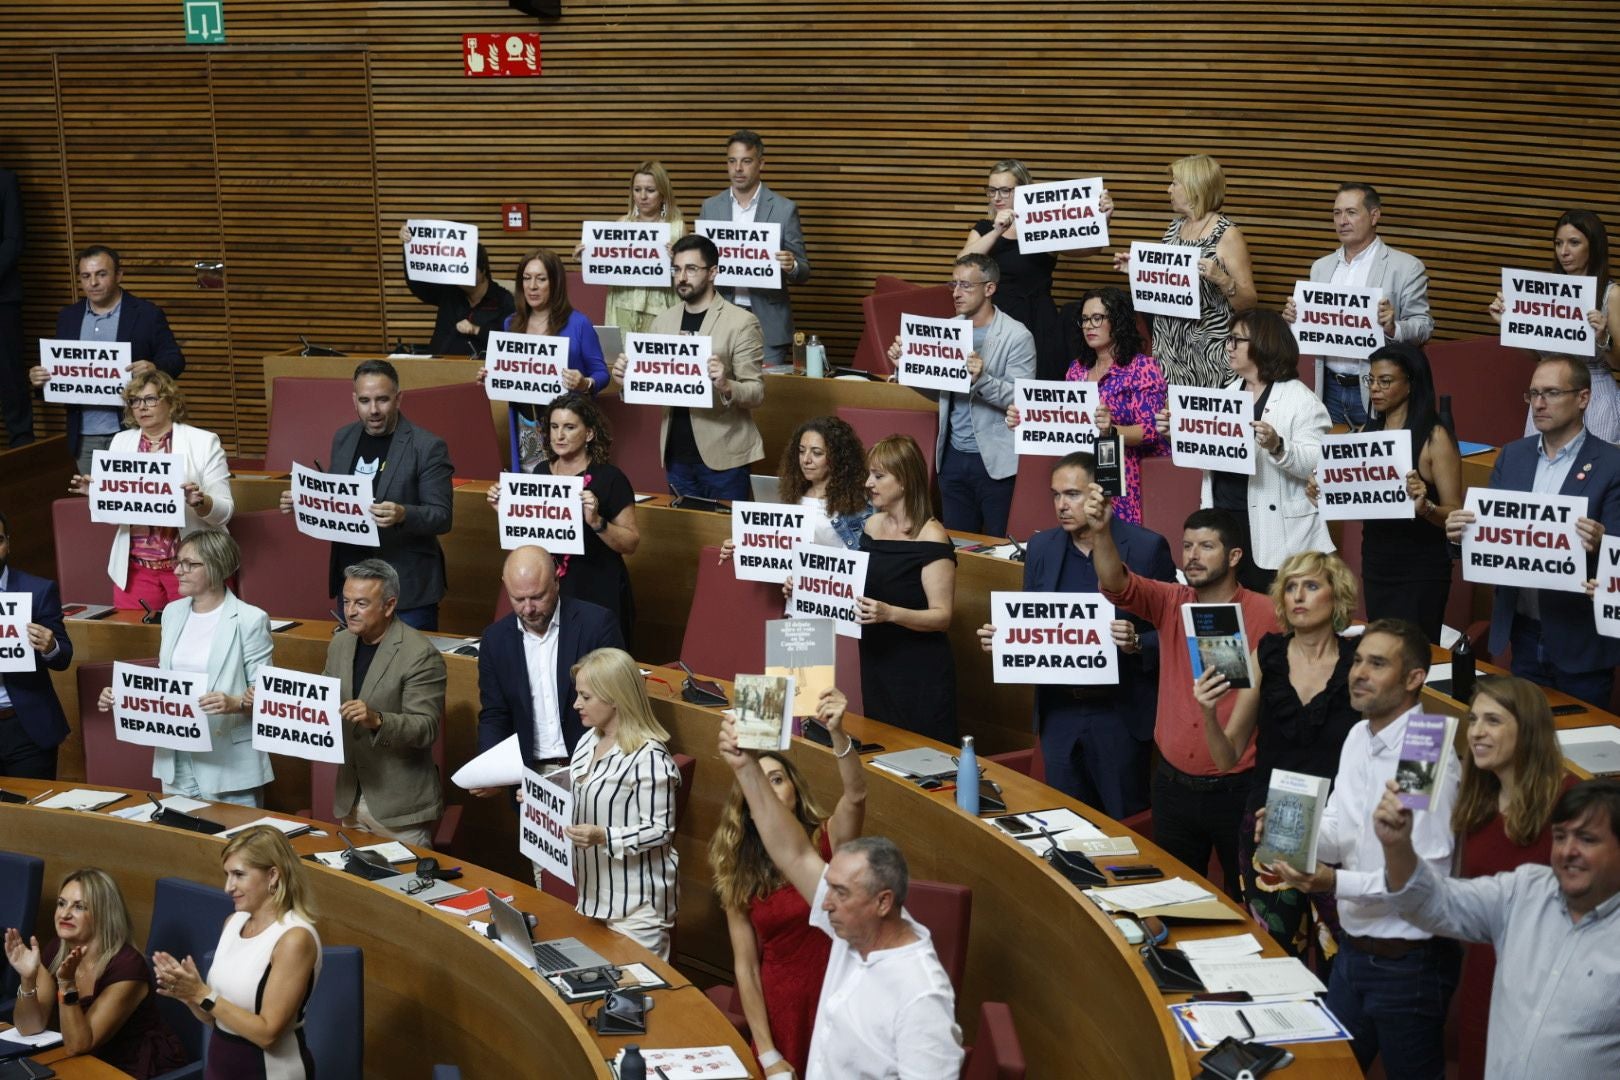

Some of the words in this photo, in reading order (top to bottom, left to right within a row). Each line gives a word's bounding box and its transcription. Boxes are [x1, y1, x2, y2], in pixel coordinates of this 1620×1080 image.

[1024, 186, 1091, 204] VERITAT
[1026, 204, 1094, 224] JUSTÍCIA
[408, 226, 467, 241] VERITAT
[593, 229, 659, 241] VERITAT
[706, 228, 769, 242] VERITAT
[1024, 222, 1100, 242] REPARACIÓ
[410, 242, 466, 258] JUSTÍCIA
[592, 243, 659, 259] JUSTÍCIA
[1138, 250, 1191, 267] VERITAT
[410, 260, 469, 274] REPARACIÓ
[589, 263, 663, 276] REPARACIÓ
[718, 264, 774, 277] PARACIÓ
[1136, 268, 1190, 287] JUSTÍCIA
[1136, 289, 1193, 307] REPARACIÓ
[1513, 278, 1582, 299] VERITAT
[1303, 290, 1370, 308] VERITAT
[1302, 308, 1372, 329] JUSTÍCIA
[1512, 299, 1583, 321] JUSTÍCIA
[906, 323, 961, 340] VERITAT
[1300, 331, 1377, 348] REPARACIÓ
[1509, 322, 1587, 342] REPARACIÓ
[51, 347, 119, 361] VERITAT
[496, 340, 557, 357] VERITAT
[634, 341, 699, 356] VERITAT
[907, 341, 964, 360] JUSTÍCIA
[51, 362, 120, 379] JUSTÍCIA
[494, 357, 558, 376] JUSTÍCIA
[634, 358, 701, 376] JUSTÍCIA
[905, 362, 967, 379] REPARACIÓ
[50, 382, 122, 395] REPARACIÓ
[492, 378, 561, 393] REPARACIÓ
[631, 380, 705, 395] REPARACIÓ
[1023, 388, 1087, 403] VERITAT
[1179, 395, 1242, 414] VERITAT
[1024, 405, 1091, 424] JUSTÍCIA
[1178, 416, 1243, 438] JUSTÍCIA
[1023, 430, 1095, 444] REPARACIÓ
[1177, 441, 1247, 460] REPARACIÓ
[1322, 440, 1395, 460] VERITAT
[100, 459, 171, 474] VERITAT
[1323, 461, 1399, 484] JUSTÍCIA
[99, 476, 172, 495] JUSTÍCIA
[298, 473, 359, 496] VERITAT
[509, 482, 571, 498] VERITAT
[98, 499, 176, 514] REPARACIÓ
[298, 494, 363, 516] JUSTÍCIA
[1326, 490, 1406, 504] REPARACIÓ
[507, 500, 572, 520] JUSTÍCIA
[741, 511, 804, 528] VERITAT
[1478, 499, 1571, 523] VERITAT
[299, 512, 369, 534] REPARACIÓ
[506, 525, 576, 540] REPARACIÓ
[1475, 525, 1570, 550] JUSTÍCIA
[799, 552, 856, 575] VERITAT
[1471, 552, 1576, 575] REPARACIÓ
[798, 576, 853, 599] JUSTÍCIA
[797, 599, 856, 622] REPARACIÓ
[1005, 603, 1098, 619] VERITAT
[1005, 623, 1101, 646] JUSTÍCIA
[1002, 651, 1107, 669] REPARACIÓ
[122, 673, 193, 696] VERITAT
[262, 675, 329, 701] VERITAT
[121, 695, 194, 718] JUSTÍCIA
[260, 699, 329, 725] JUSTÍCIA
[120, 717, 201, 738] REPARACIÓ
[257, 724, 334, 748] REPARACIÓ
[524, 777, 565, 815] VERITAT
[524, 802, 564, 842] JUSTÍCIA
[523, 827, 568, 866] REPARACIÓ
